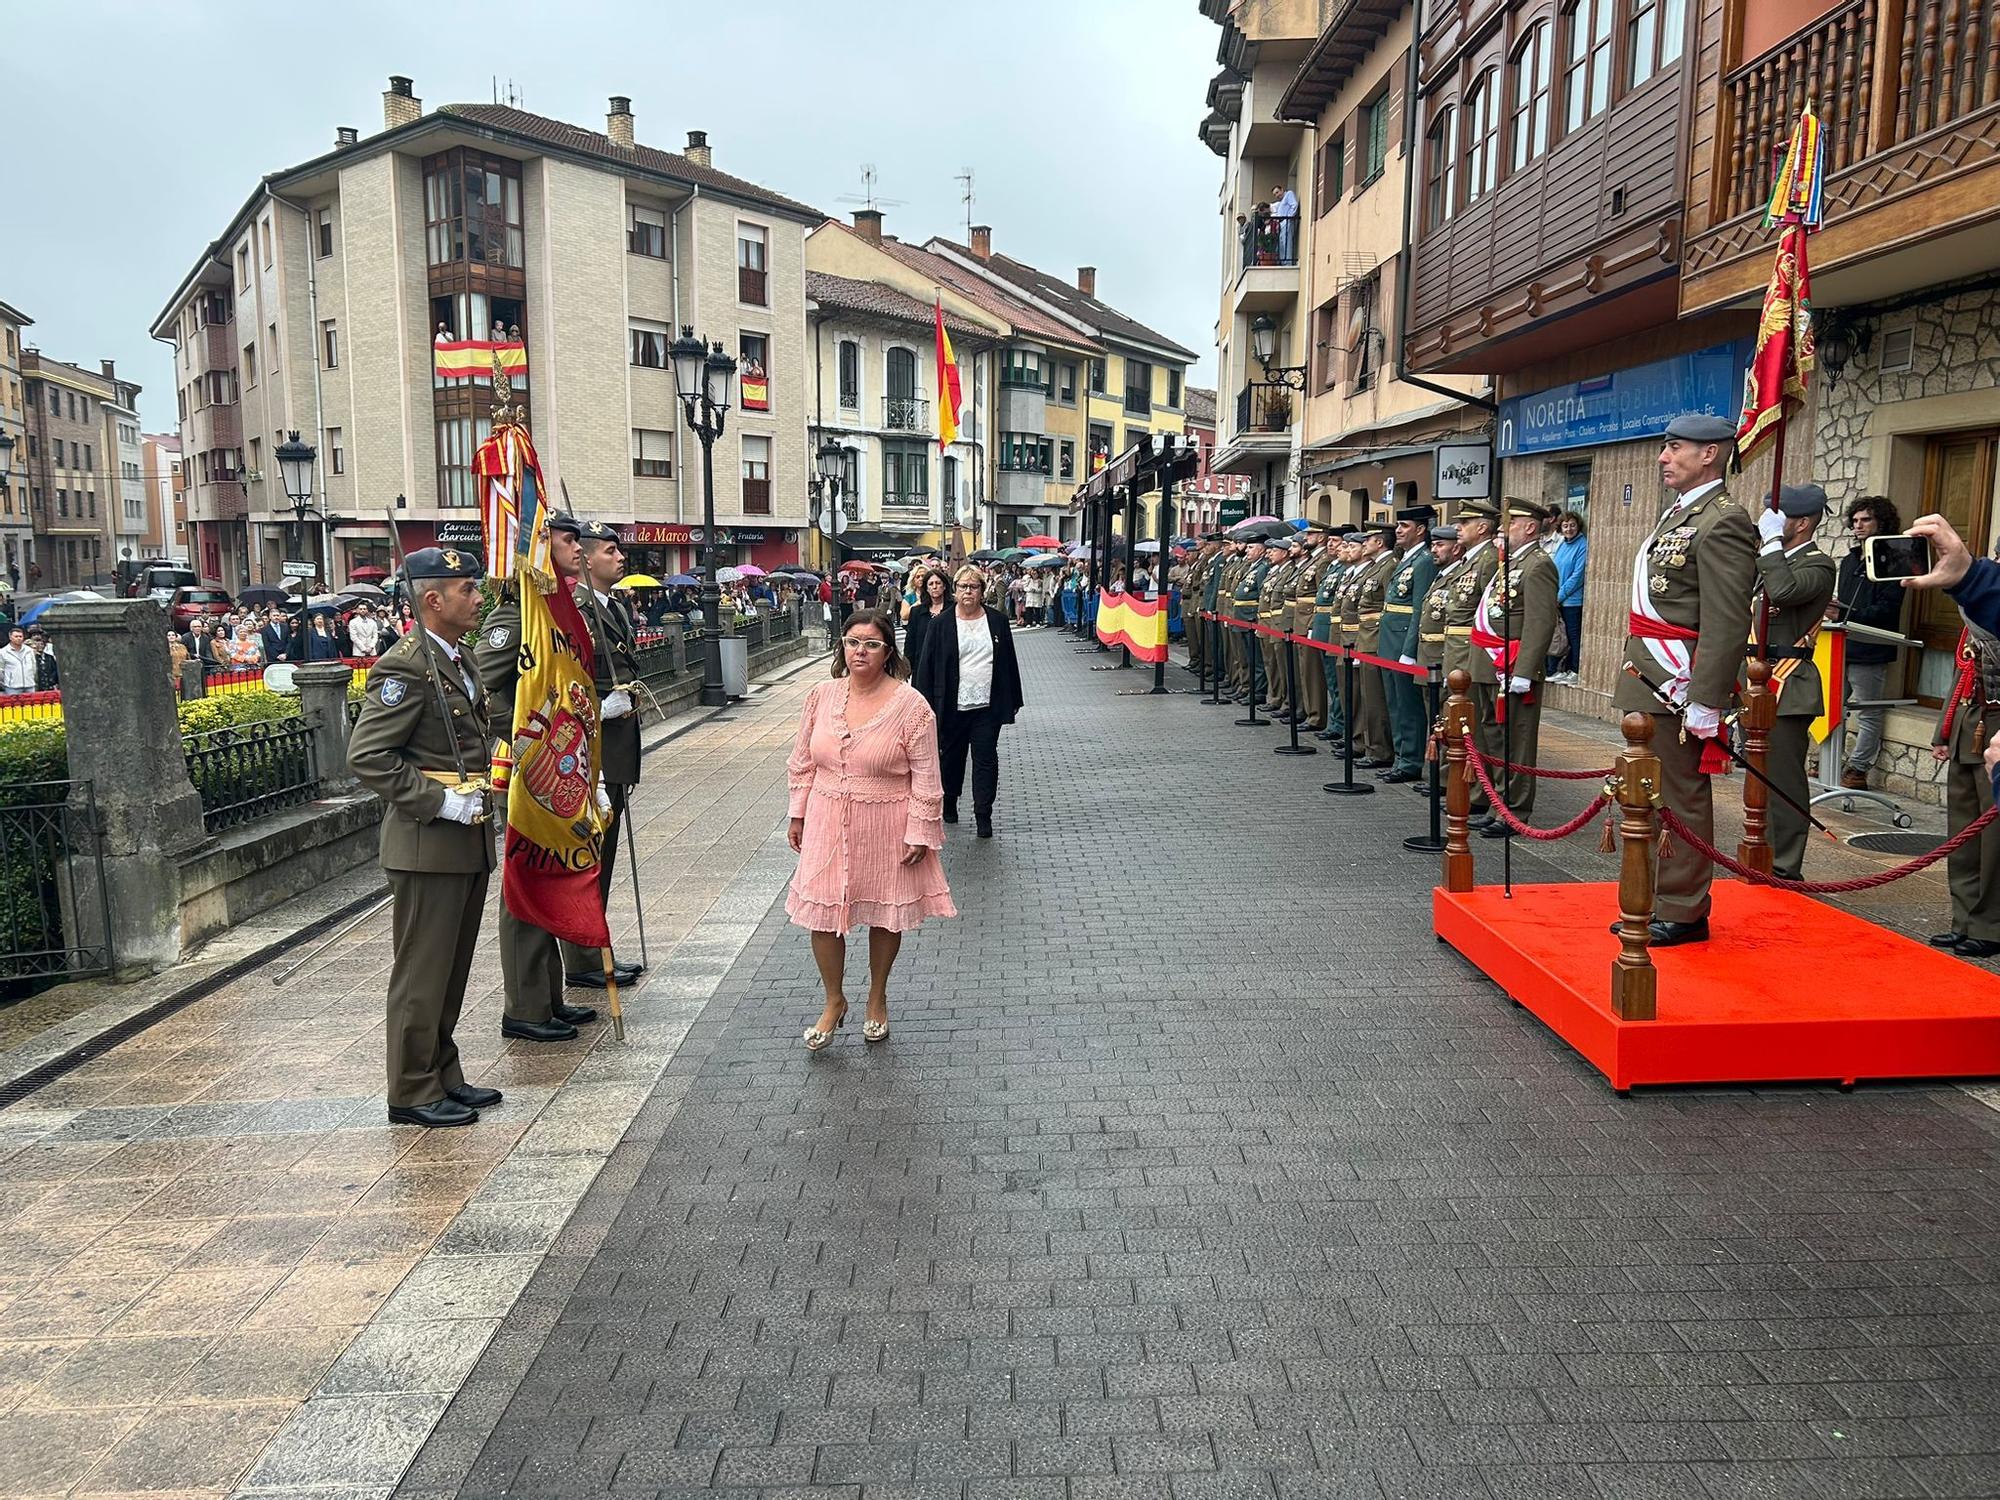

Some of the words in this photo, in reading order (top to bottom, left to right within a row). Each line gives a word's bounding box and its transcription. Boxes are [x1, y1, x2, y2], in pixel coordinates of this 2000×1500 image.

[1441, 464, 1486, 480] HATCHET
[637, 528, 650, 542] de
[653, 527, 688, 542] Marco
